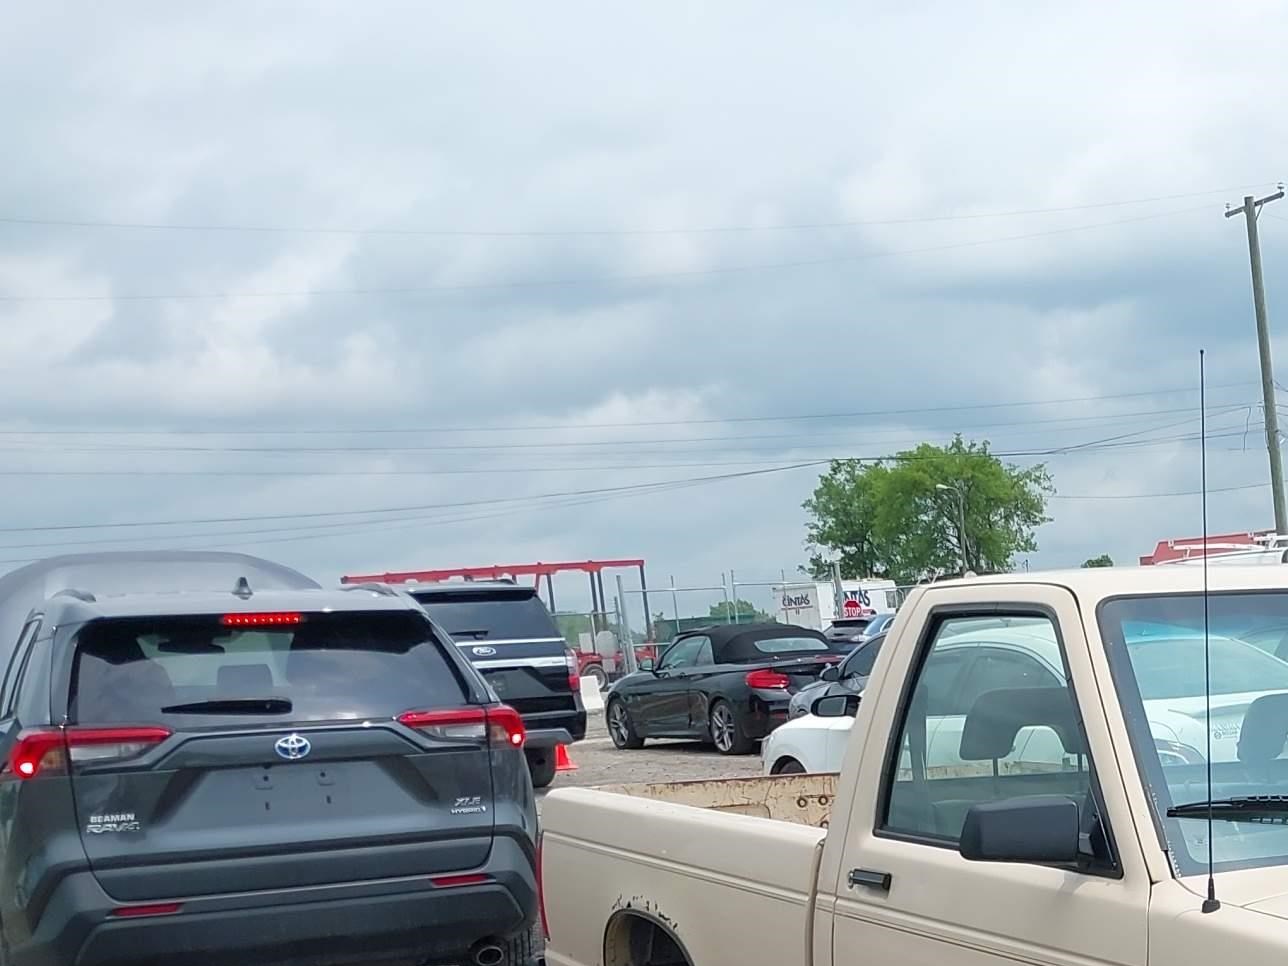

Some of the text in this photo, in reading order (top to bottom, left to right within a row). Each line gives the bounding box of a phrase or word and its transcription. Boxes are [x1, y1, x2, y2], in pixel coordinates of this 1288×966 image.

[782, 592, 810, 607] CINTAS
[843, 607, 860, 617] STOP
[454, 796, 481, 807] XLE
[90, 813, 135, 823] BEAMAN
